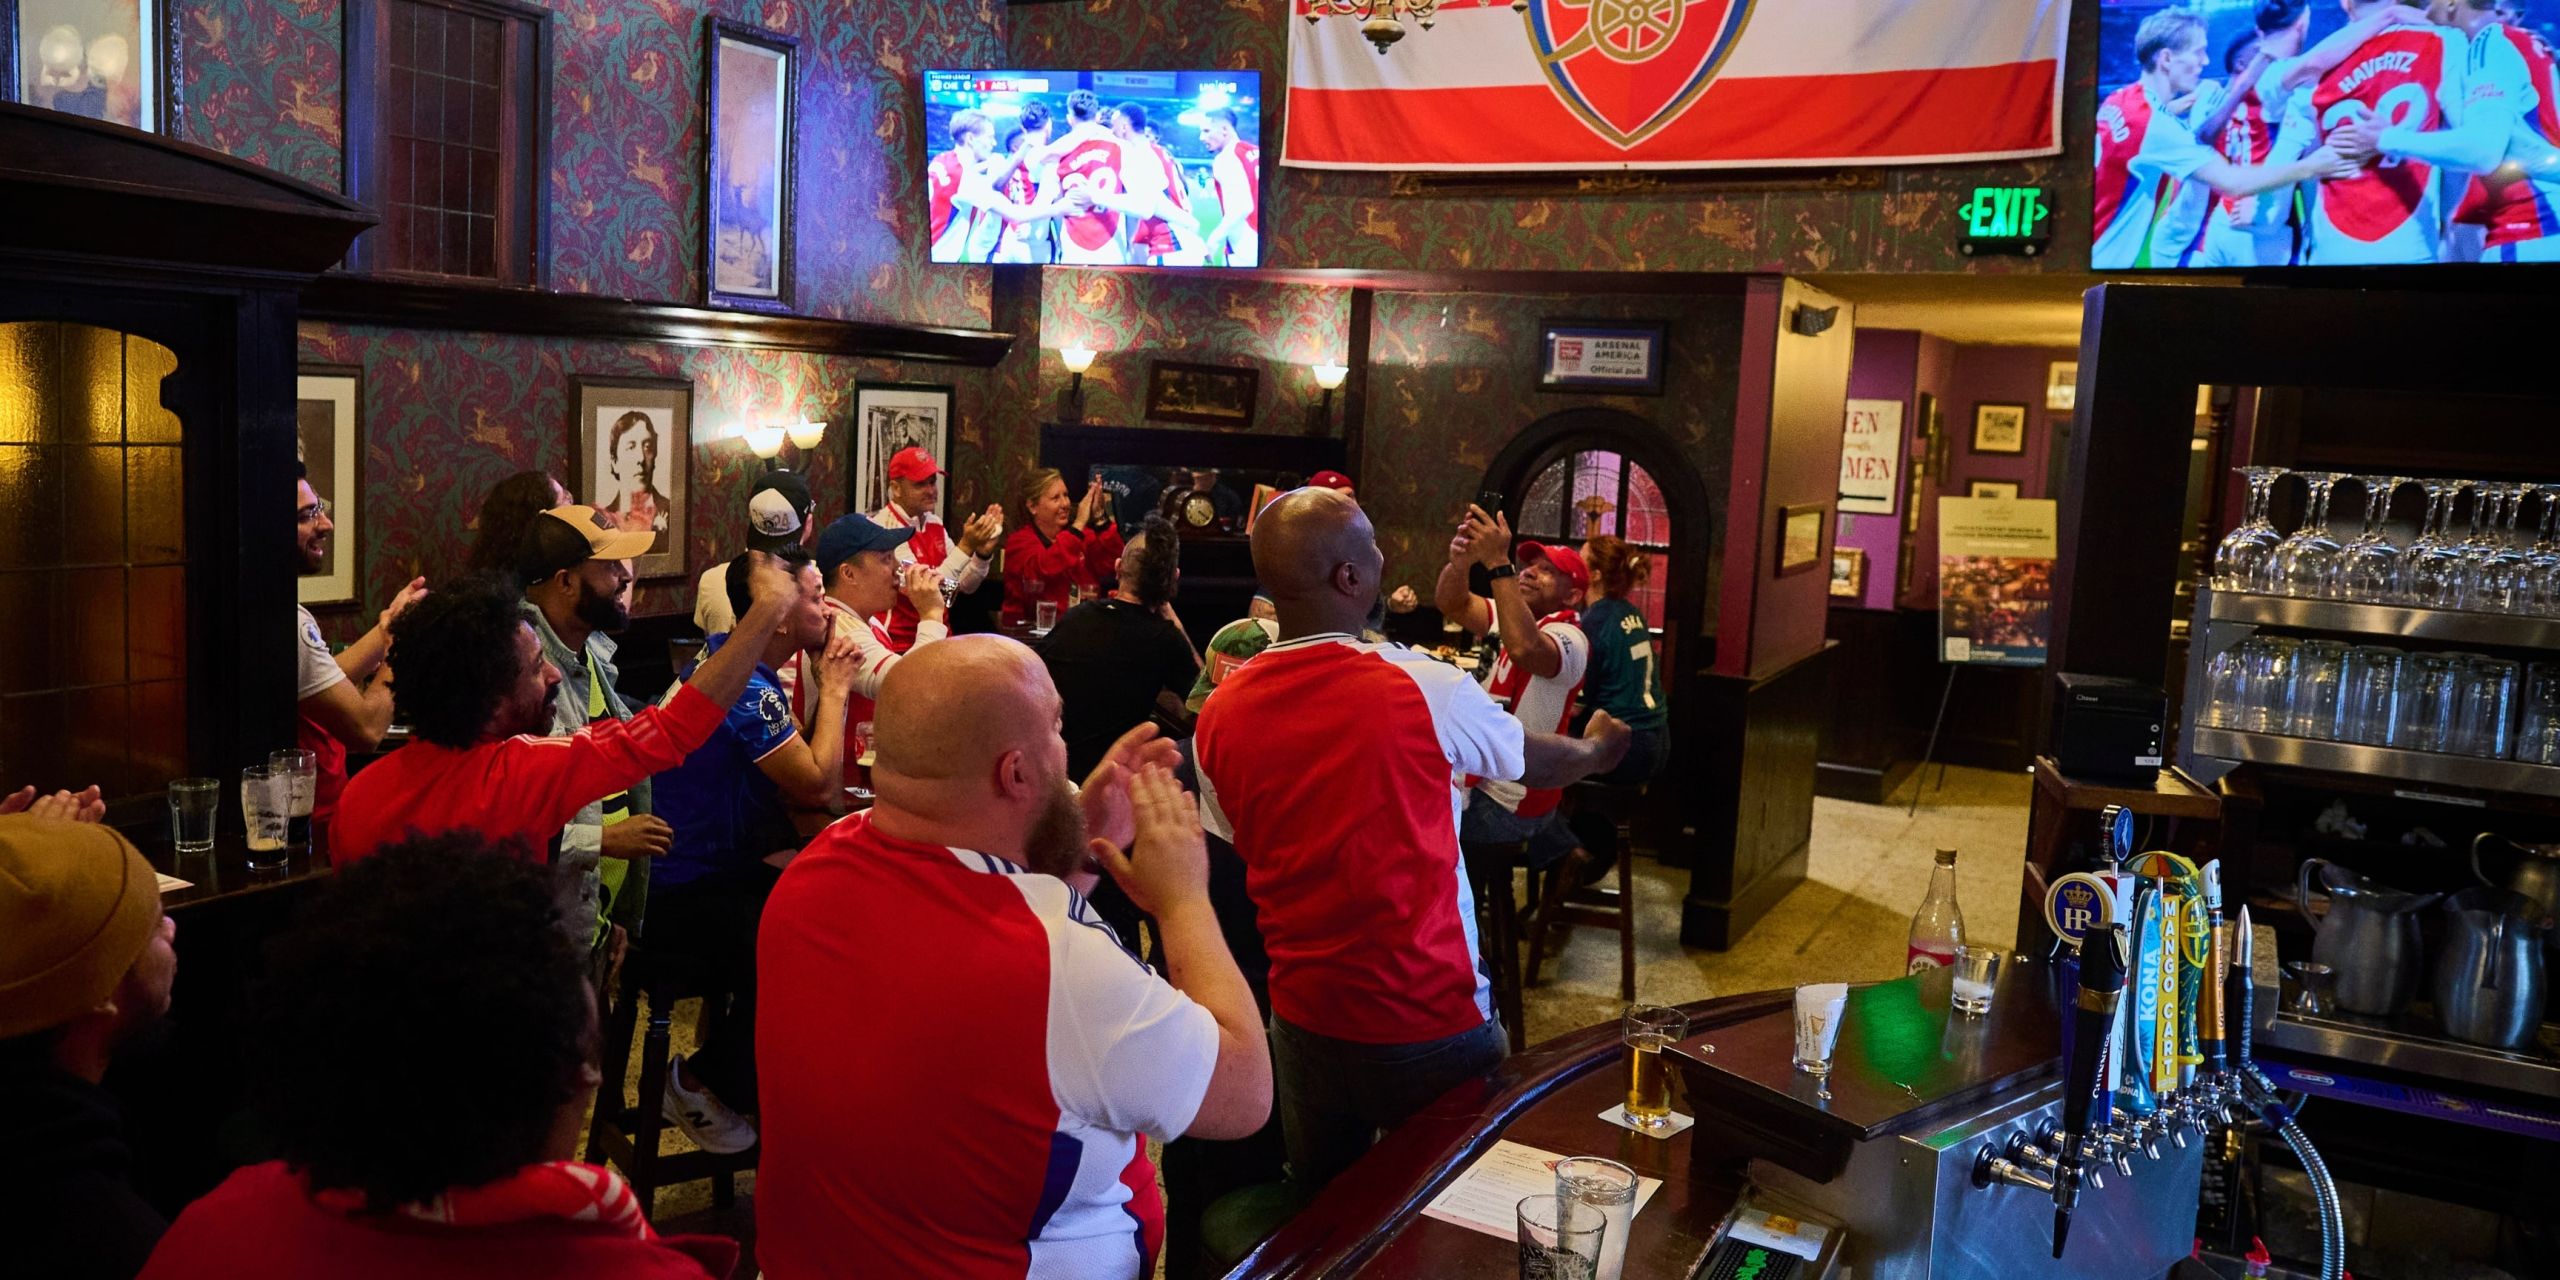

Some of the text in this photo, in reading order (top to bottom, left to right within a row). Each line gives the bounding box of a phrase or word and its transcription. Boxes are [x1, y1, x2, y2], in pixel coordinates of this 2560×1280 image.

[943, 82, 958, 90] CHE
[980, 81, 986, 91] 1
[2338, 51, 2419, 93] HAVERTZ
[1969, 187, 2041, 237] EXIT
[1594, 341, 1641, 350] ARSENAL
[1595, 351, 1640, 360] AMERICA
[1590, 365, 1623, 374] Official
[1625, 366, 1643, 376] pub
[1630, 640, 1656, 709] 7
[2163, 902, 2175, 992] MANGO
[2140, 949, 2162, 1022] KONA
[2163, 1004, 2174, 1076] CART
